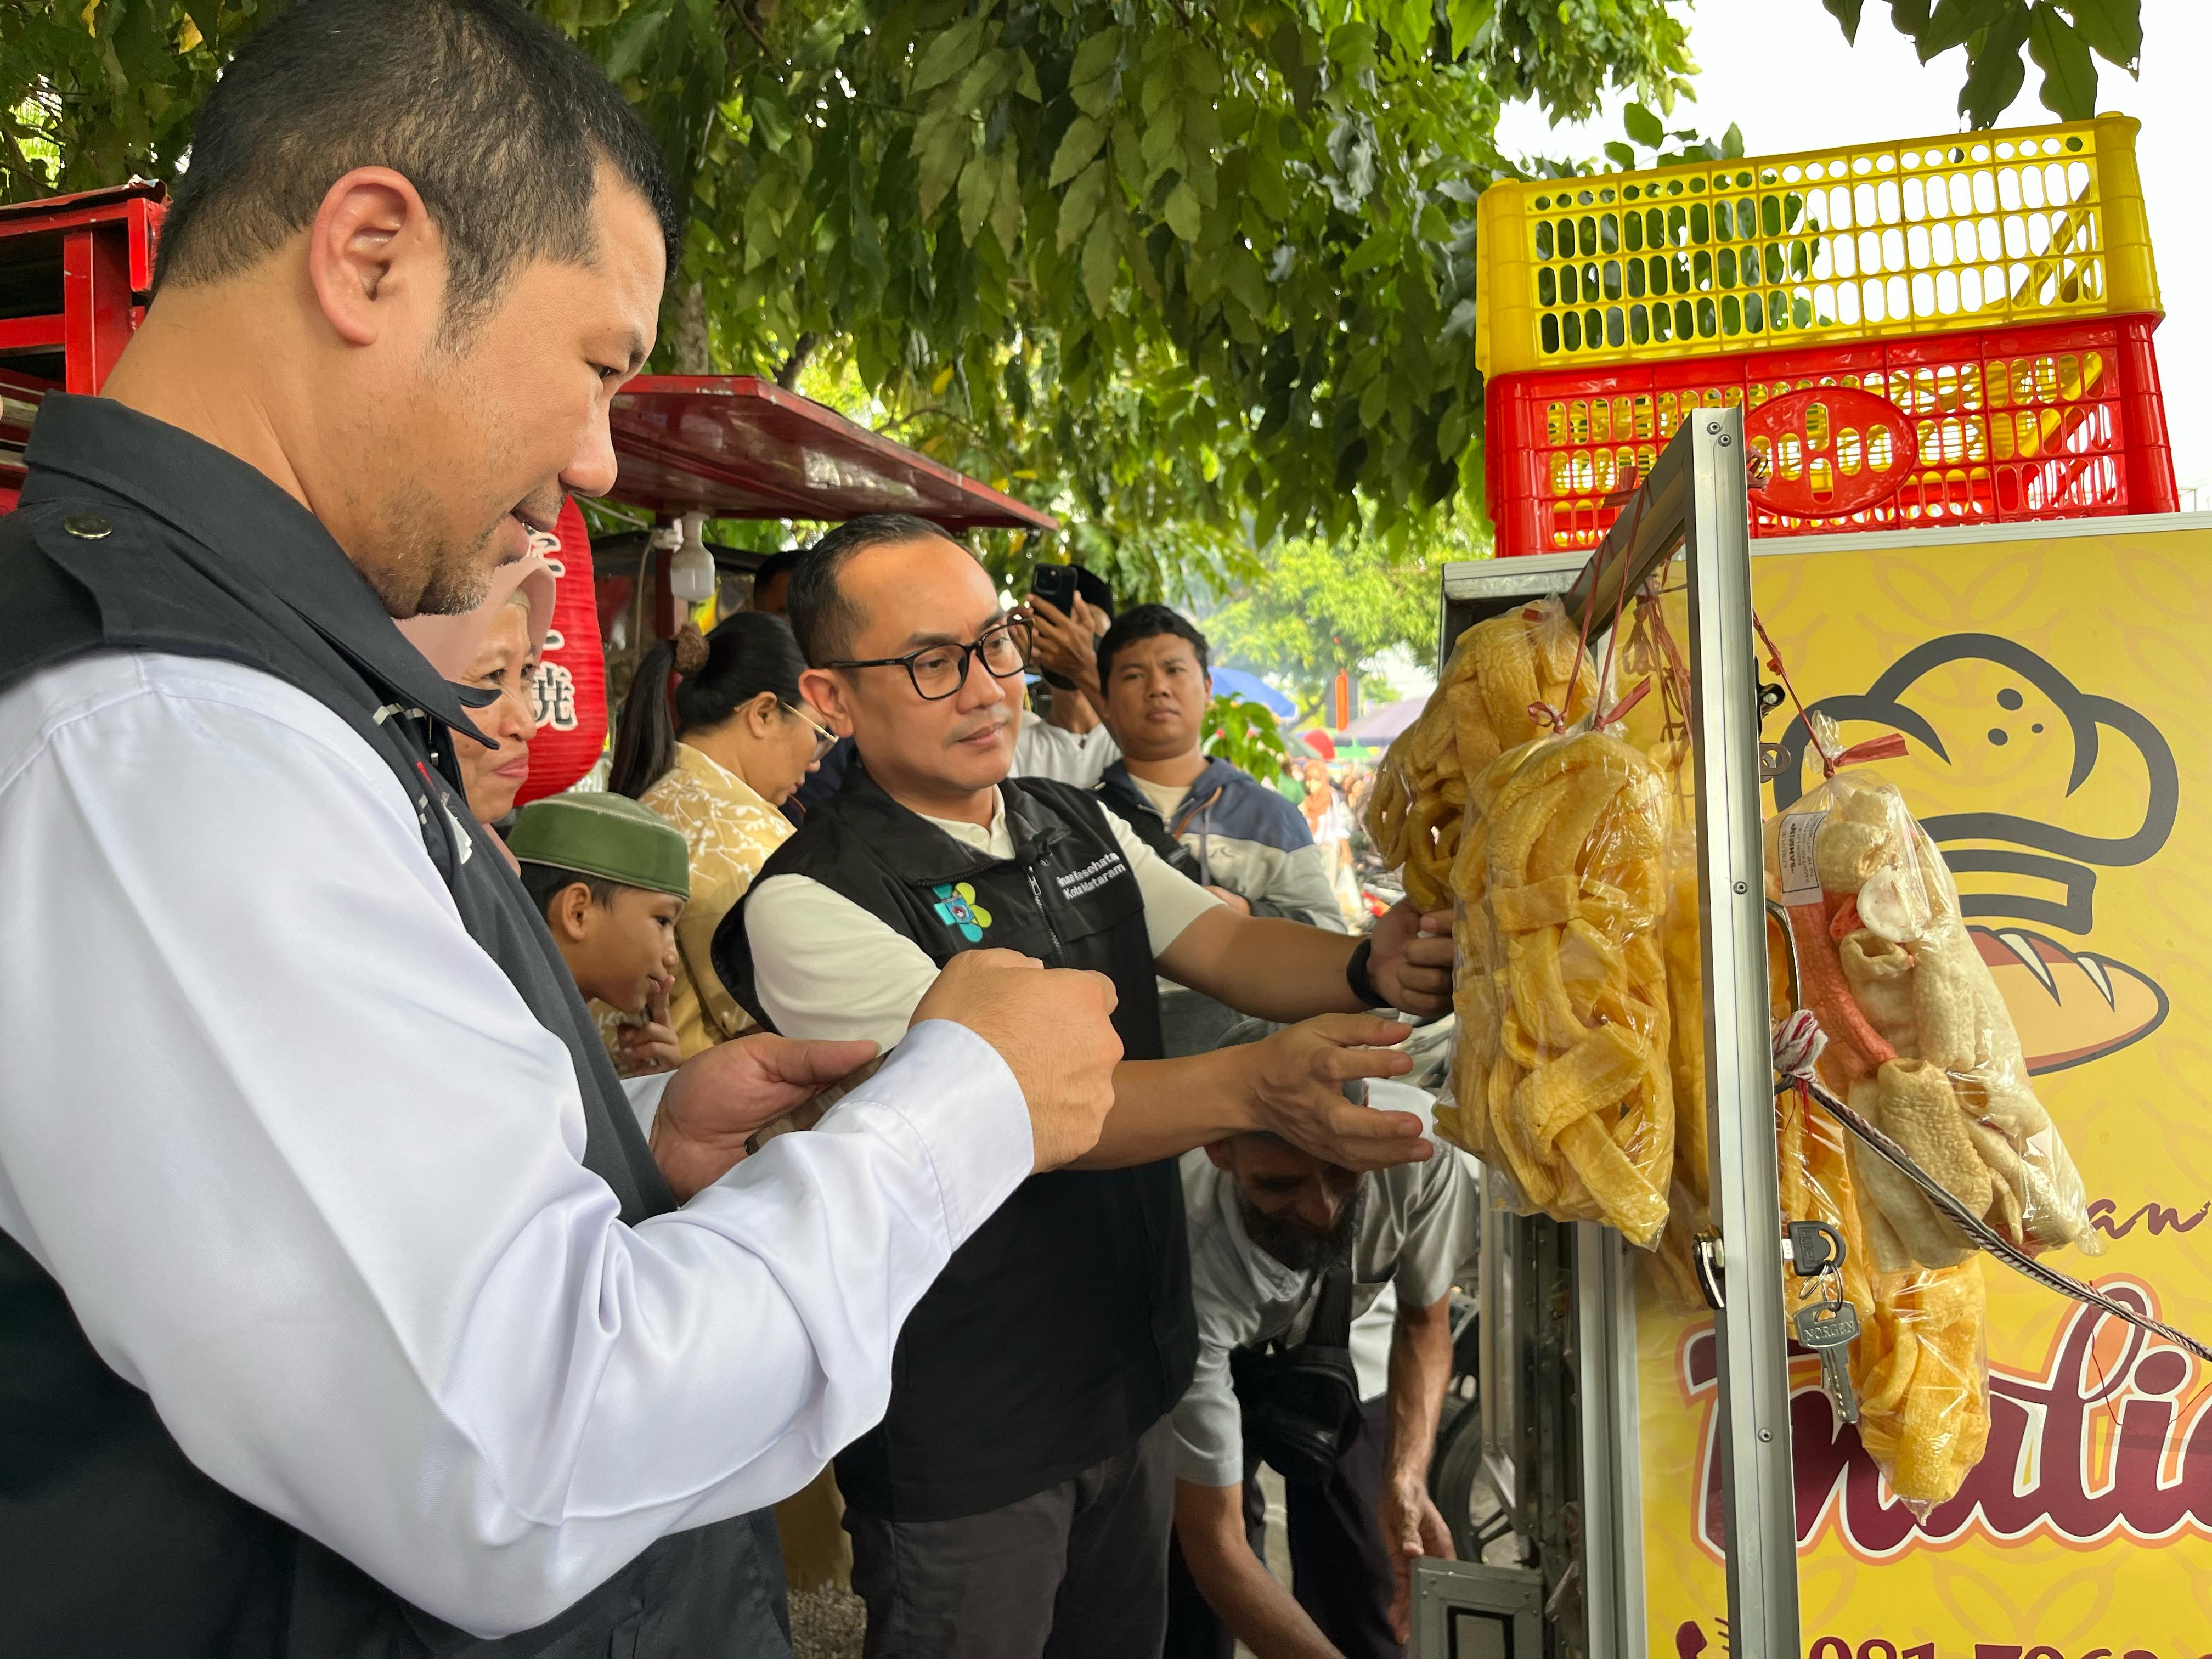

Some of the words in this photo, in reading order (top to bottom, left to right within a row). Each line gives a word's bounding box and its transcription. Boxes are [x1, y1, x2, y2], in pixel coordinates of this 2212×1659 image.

[1072, 853, 1120, 881] Kesehata
[1080, 864, 1126, 893] Mataram
[1804, 1321, 1854, 1341] NORGEN
